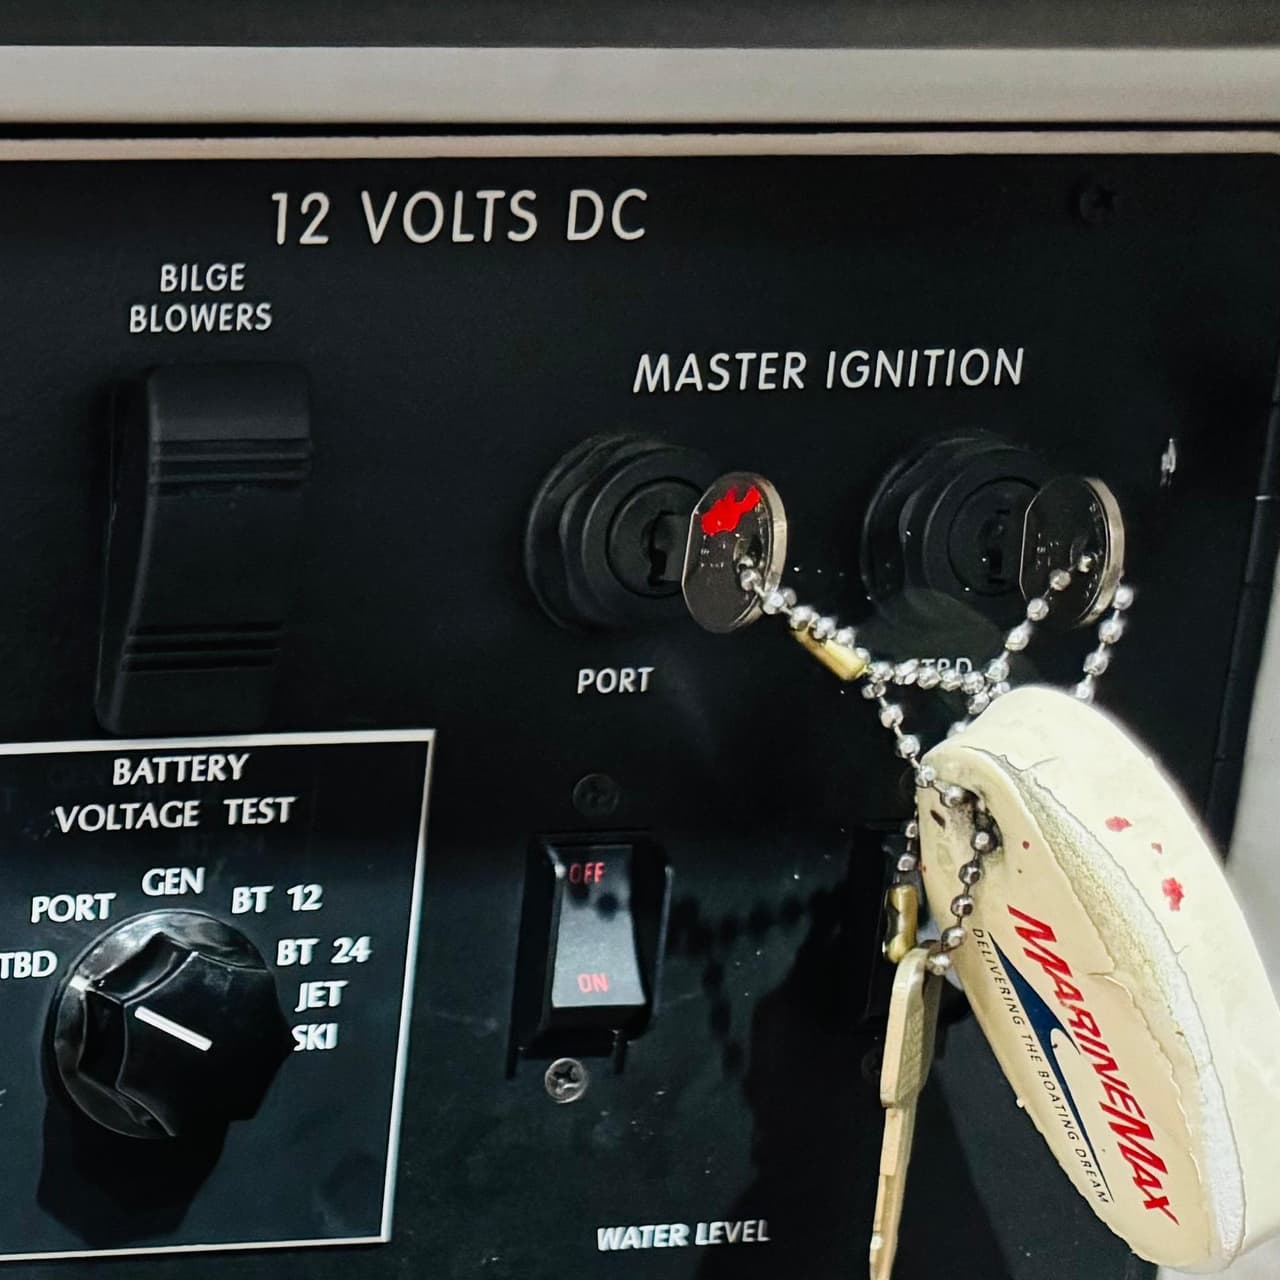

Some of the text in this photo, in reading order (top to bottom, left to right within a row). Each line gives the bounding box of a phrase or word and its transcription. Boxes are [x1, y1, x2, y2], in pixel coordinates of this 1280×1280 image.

[272, 189, 648, 245] 12 VOLTS DC
[160, 264, 246, 292] BILGE
[129, 303, 272, 332] BLOWERS
[634, 348, 1025, 394] MASTER IGNITION
[577, 667, 654, 694] PORT
[113, 754, 250, 786] BATTERY
[55, 796, 297, 833] VOLTAGE TEST
[141, 867, 205, 896] GEN
[569, 863, 605, 884] OFF
[31, 893, 116, 924] PORT
[232, 884, 323, 915] BT 12
[277, 937, 372, 966] BT 24
[295, 980, 348, 1012] JET
[578, 973, 608, 994] ON
[293, 1023, 337, 1052] SKI
[973, 928, 1109, 1205] DELIVERING THE BOATING DREAM
[597, 1219, 769, 1251] WATER LEVEL
